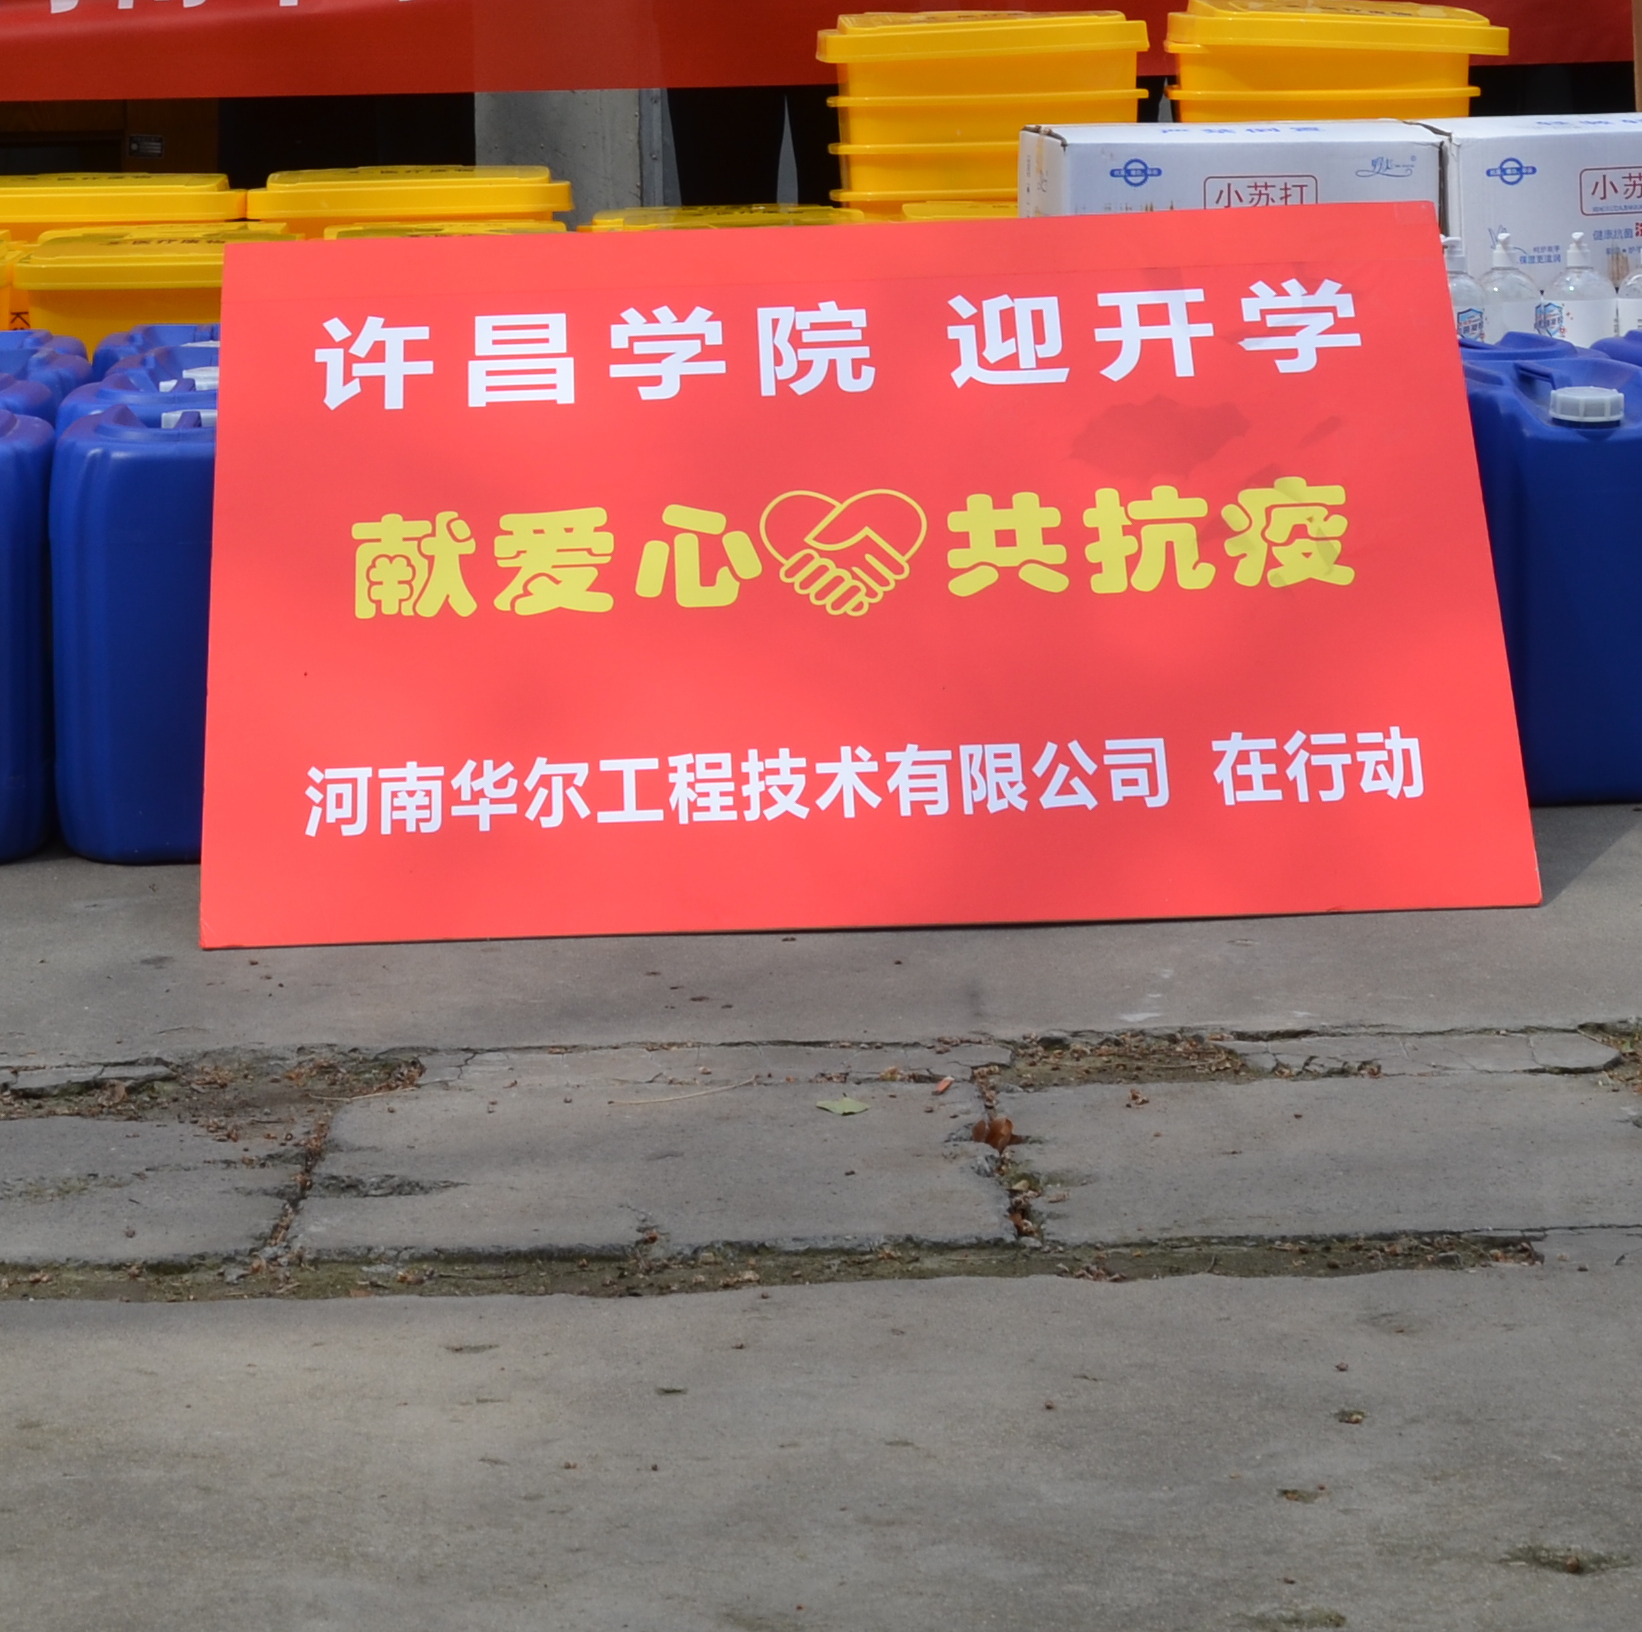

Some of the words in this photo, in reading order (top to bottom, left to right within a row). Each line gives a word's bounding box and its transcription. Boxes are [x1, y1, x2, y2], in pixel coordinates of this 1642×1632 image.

[1215, 181, 1309, 208] 小苏打
[313, 301, 875, 412] 许昌学院
[947, 279, 1363, 390] 迎开学
[350, 505, 763, 620] 献爱心
[945, 476, 1356, 599] 共抗疫
[303, 737, 1170, 839] 河南华尔工程技术有限公司
[1211, 725, 1426, 807] 在行动
